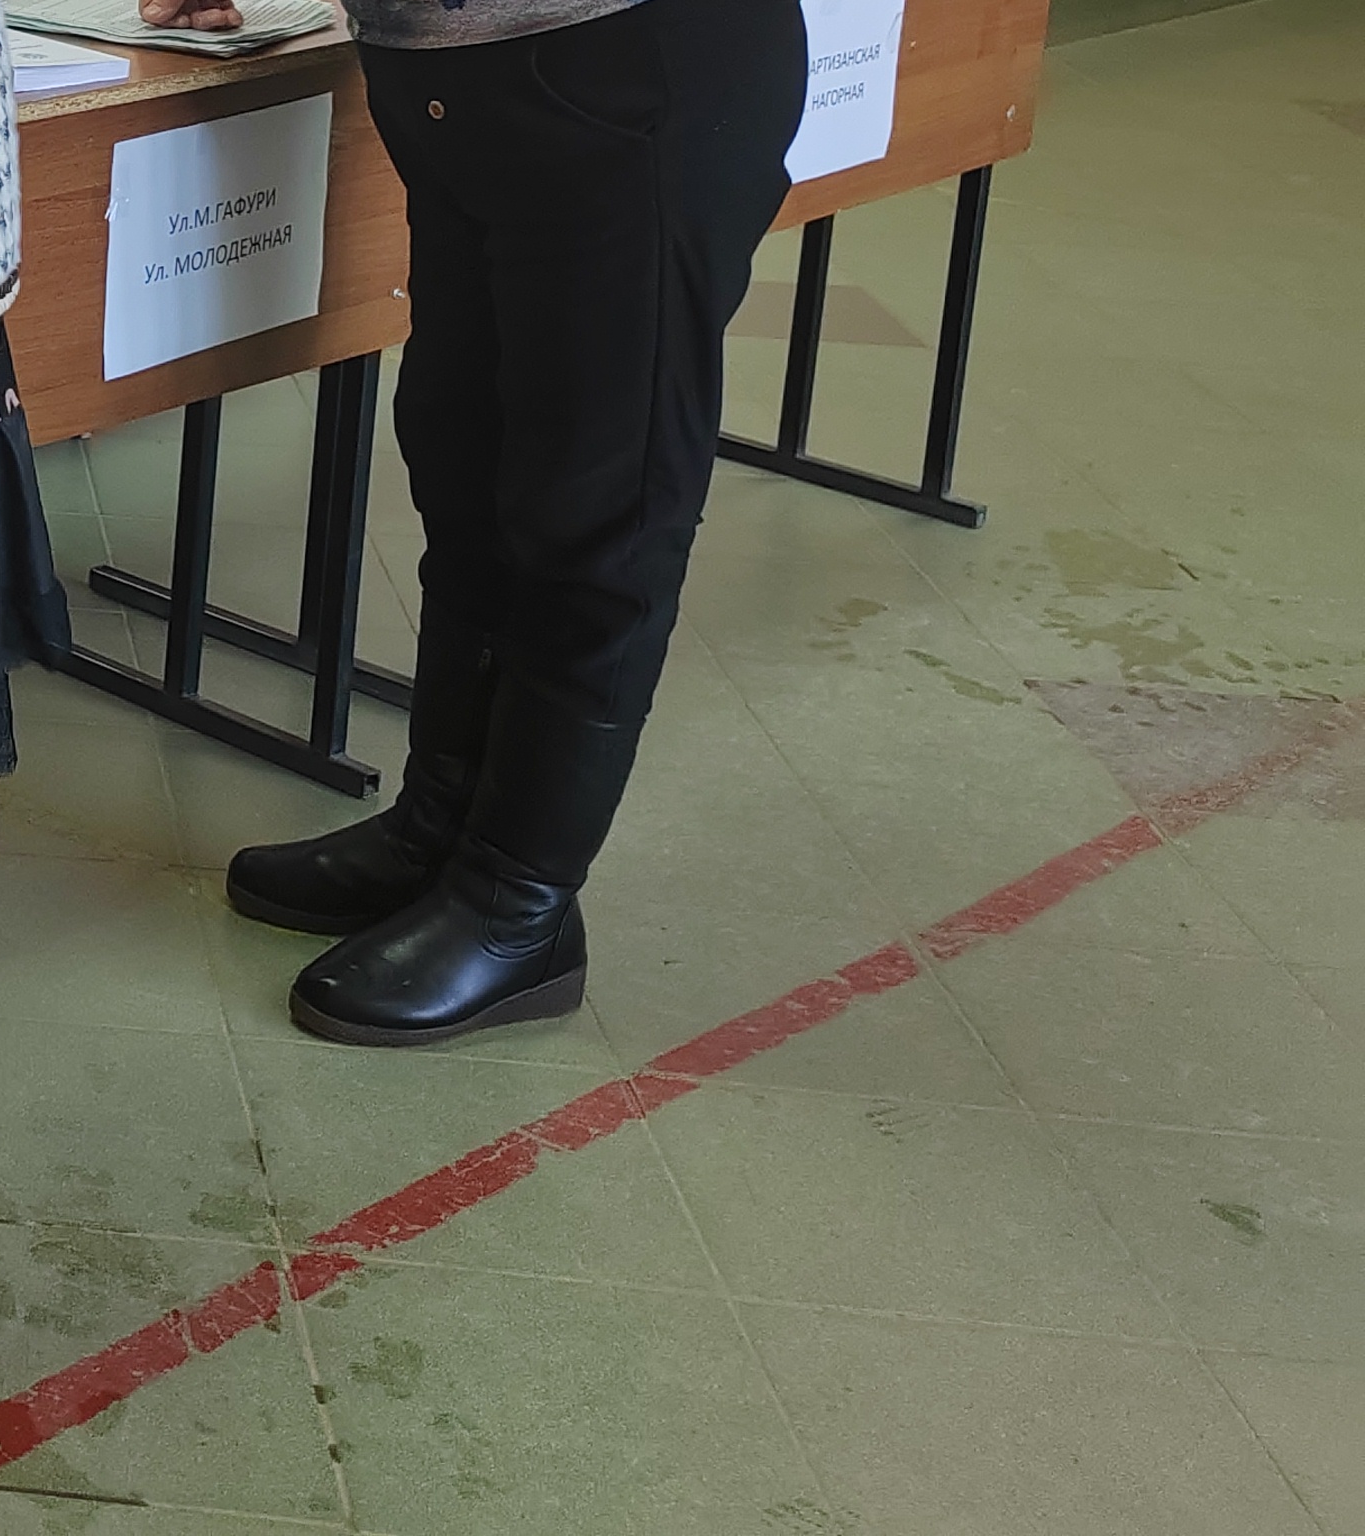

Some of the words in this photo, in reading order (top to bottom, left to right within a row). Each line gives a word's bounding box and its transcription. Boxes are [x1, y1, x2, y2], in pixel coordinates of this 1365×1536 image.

[808, 44, 882, 77] АРТИЗАНСКАЯ
[811, 82, 865, 111] НАГОРНАЯ
[144, 264, 169, 285] Ул.
[174, 224, 293, 277] МОЛОДЕЖНАЯ
